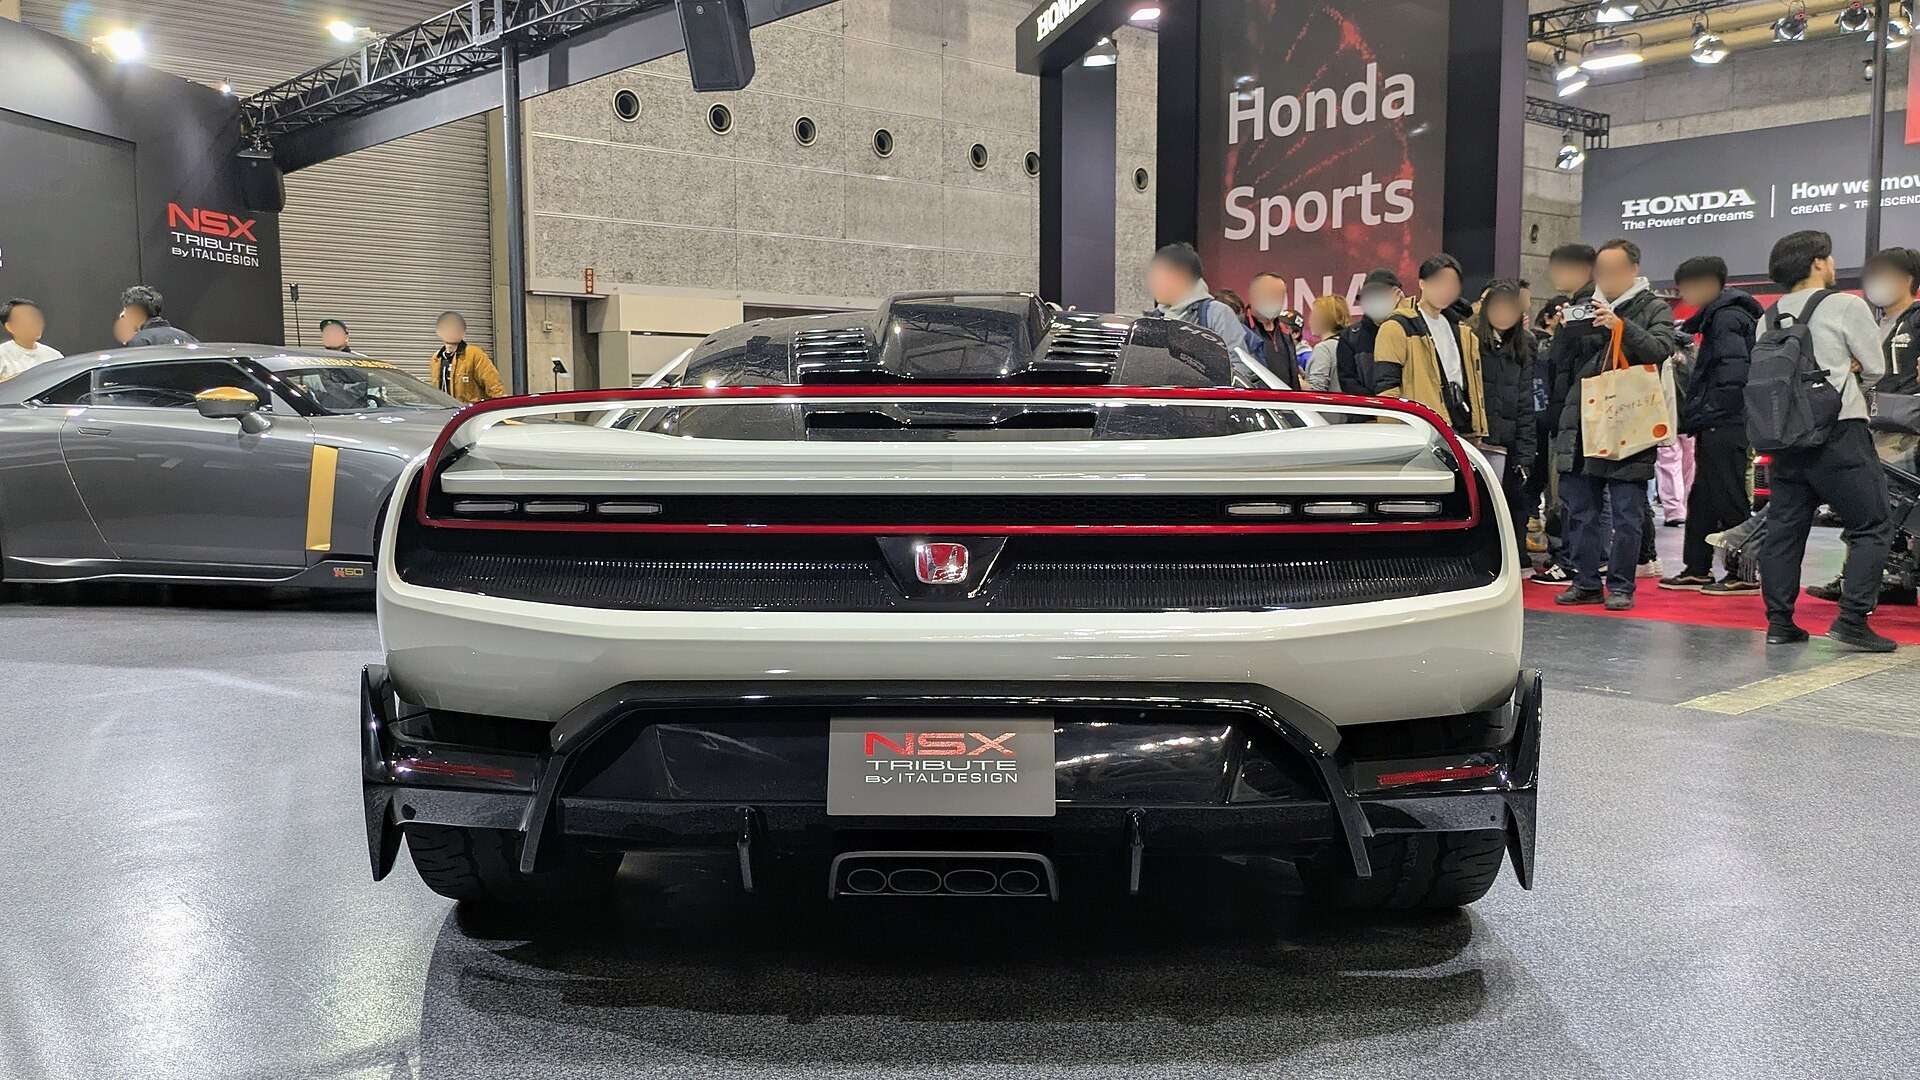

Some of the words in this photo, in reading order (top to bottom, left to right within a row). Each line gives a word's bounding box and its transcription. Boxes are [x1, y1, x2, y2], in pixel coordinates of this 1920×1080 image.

[1228, 62, 1415, 145] Honda
[1791, 182, 1839, 200] How
[1224, 171, 1415, 251] Sports
[1621, 188, 1756, 218] HONDA
[1790, 203, 1832, 215] CREATE
[168, 202, 257, 242] NSX
[1622, 220, 1646, 231] The
[1647, 216, 1686, 229] Power
[1687, 213, 1702, 225] of
[1703, 210, 1754, 224] Dreams
[171, 231, 258, 256] TRIBUTE
[171, 246, 189, 258] By
[191, 247, 259, 267] ITALDESIGN
[864, 732, 1017, 757] NSX
[865, 760, 1017, 771] TRIBUTE
[865, 775, 893, 785] By
[898, 772, 1018, 784] ITALDESIGN
